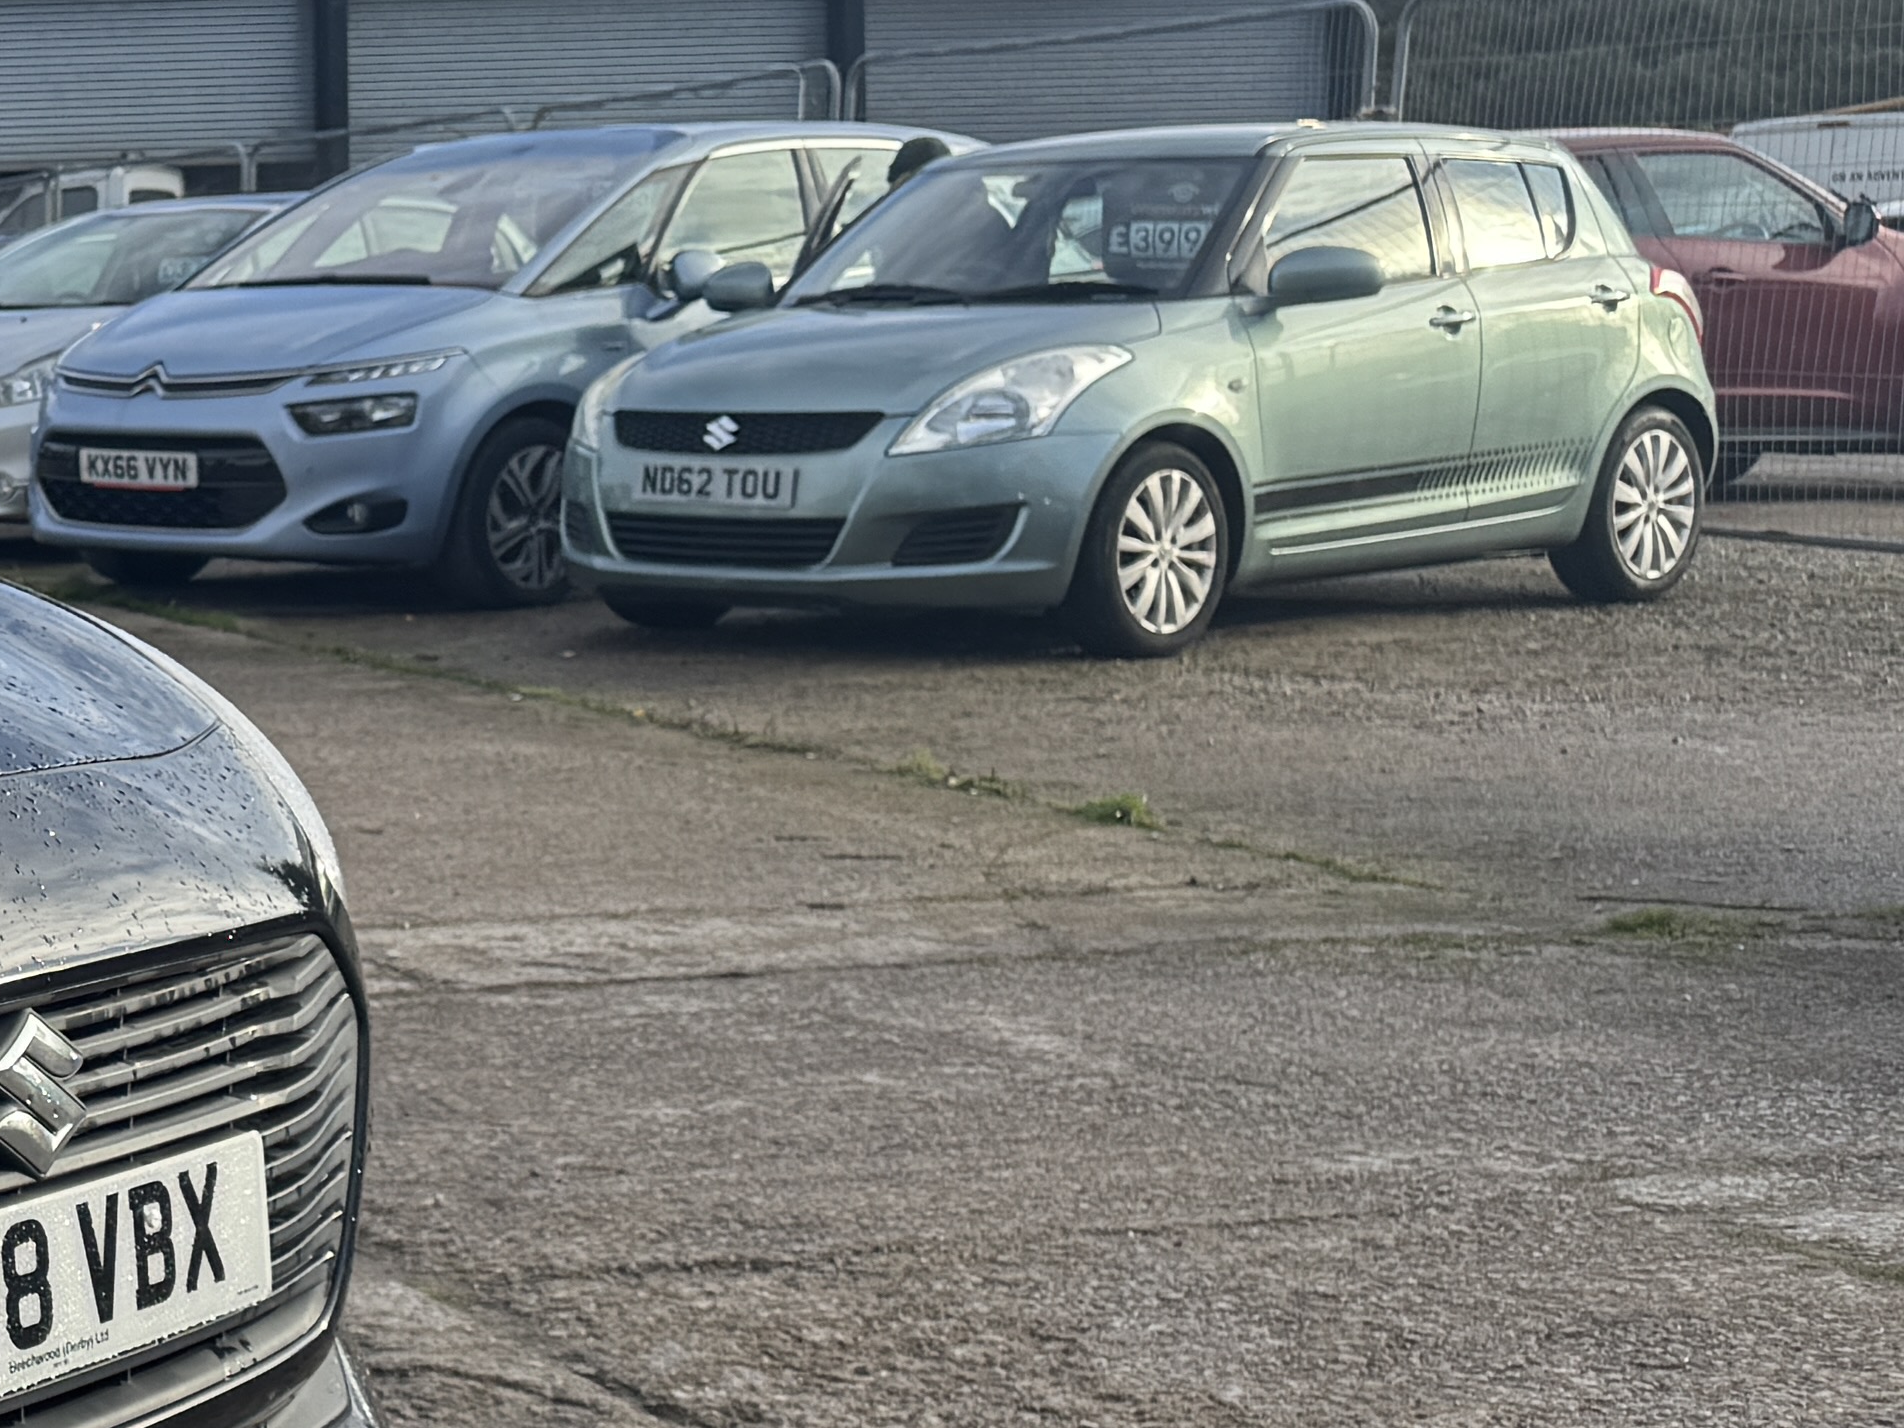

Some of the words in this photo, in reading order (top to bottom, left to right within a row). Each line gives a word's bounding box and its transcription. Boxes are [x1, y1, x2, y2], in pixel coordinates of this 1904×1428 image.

[87, 454, 139, 480] KX66
[144, 456, 188, 482] VYN
[641, 465, 714, 497] ND62
[721, 468, 781, 500] TOU
[75, 1161, 225, 1324] VBX
[95, 1328, 110, 1344] Ltd
